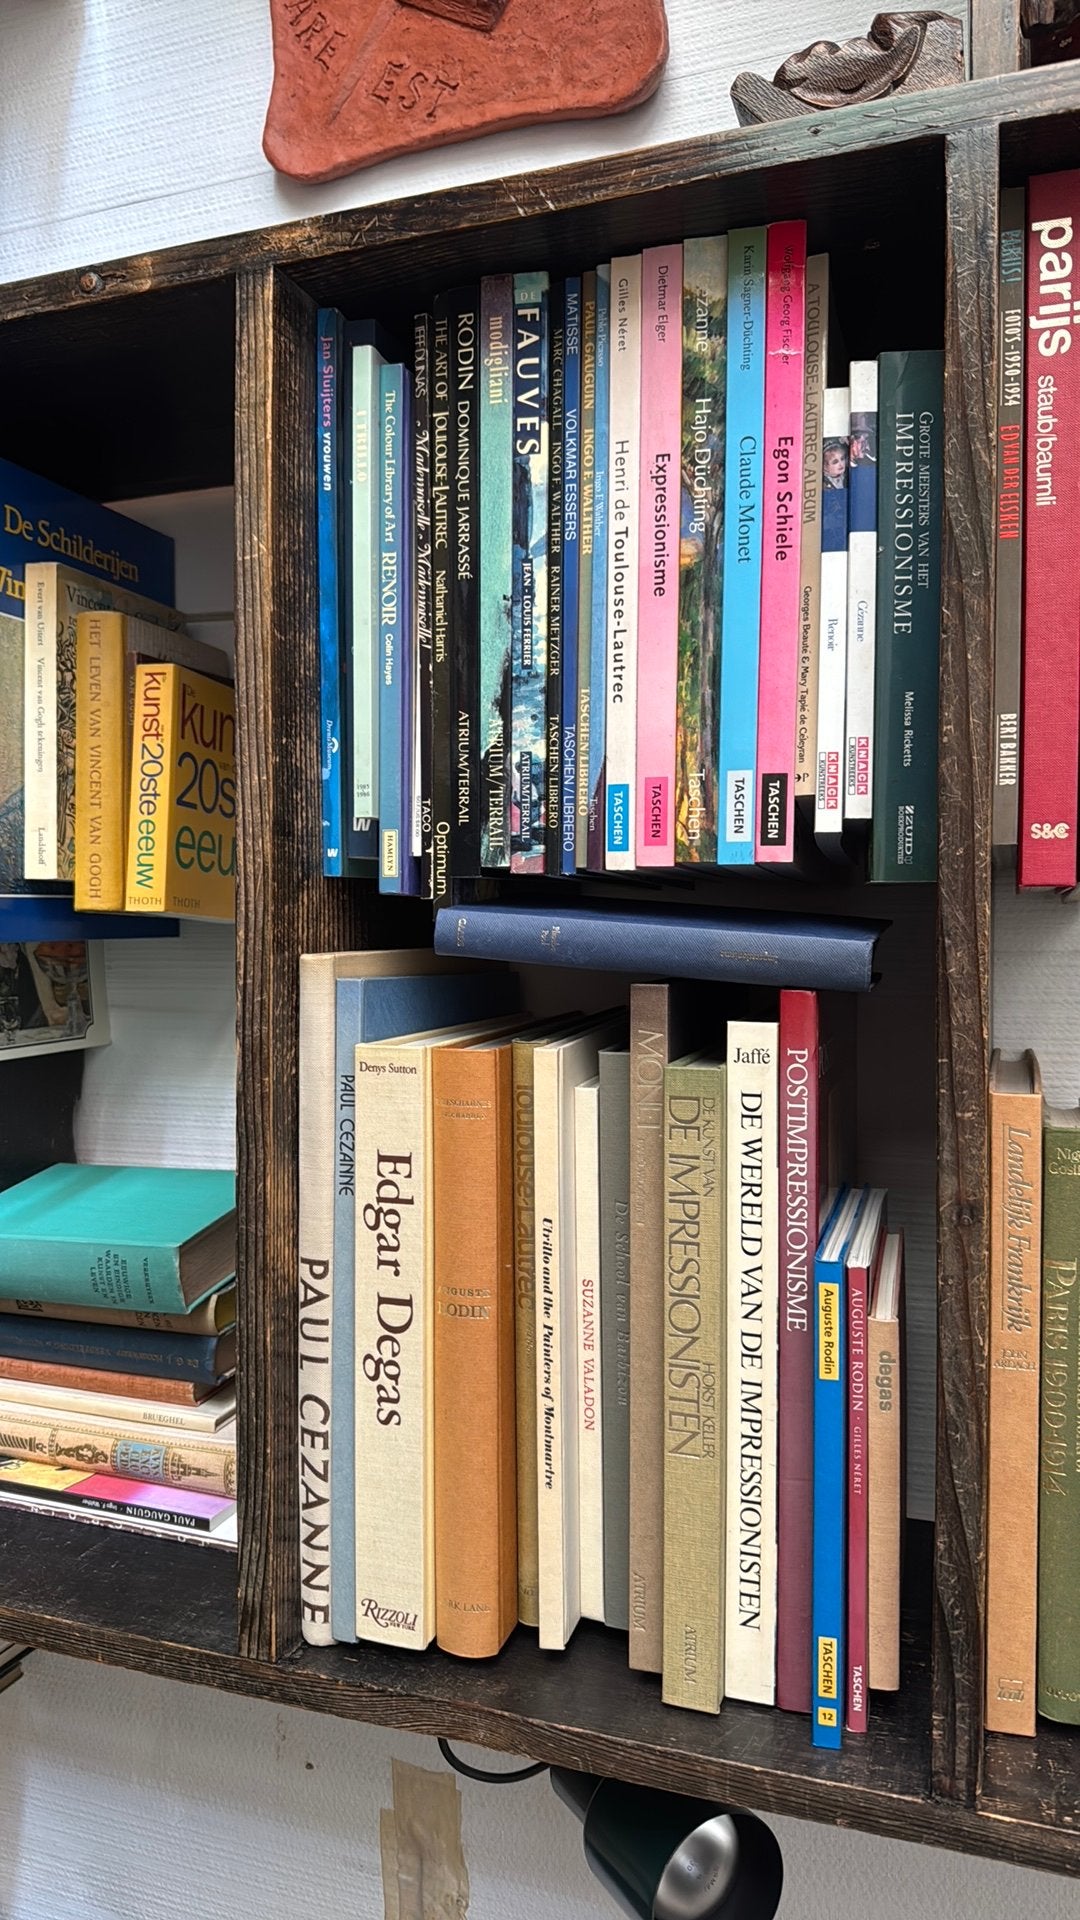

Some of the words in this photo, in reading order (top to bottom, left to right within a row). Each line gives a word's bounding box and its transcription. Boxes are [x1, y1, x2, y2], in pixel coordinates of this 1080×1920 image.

[370, 61, 460, 121] EST
[742, 245, 754, 276] Karin
[618, 278, 629, 313] Gilles
[657, 265, 669, 311] Dietmar
[808, 283, 820, 295] A
[1028, 217, 1080, 357] parijs
[435, 317, 447, 349] THE
[566, 293, 578, 356] MATISSE
[584, 301, 595, 340] PAUL
[617, 318, 629, 352] Néret
[655, 314, 668, 343] Elger
[740, 278, 754, 371] Sagner-Düchting
[322, 336, 333, 359] Jan
[435, 350, 448, 379] ART
[457, 312, 473, 390] RODIN
[485, 316, 507, 404] modigliani
[553, 329, 563, 366] MARC
[321, 365, 334, 427] Sluijters
[435, 381, 448, 401] OF
[516, 307, 540, 455] FAUVES
[552, 368, 563, 431] CHAGALL
[584, 343, 595, 410] GAUGUIN
[804, 296, 820, 464] TOULOUSE-LAUTREC
[385, 390, 396, 413] The
[691, 399, 712, 442] Hajo
[385, 415, 395, 457] Colour
[455, 400, 470, 501] DOMINIQUE
[565, 408, 577, 480] VOLKMAR
[584, 429, 595, 470] INGO
[1000, 424, 1019, 441] ED
[1001, 444, 1019, 464] VAN
[1035, 375, 1058, 507] staub/baumli
[322, 432, 333, 491] vrouwen
[382, 459, 396, 504] Library
[432, 412, 450, 549] TOULOUSE-LAUTREC
[552, 442, 562, 474] INGO
[614, 439, 629, 494] Henri
[739, 436, 756, 500] Claude
[773, 436, 793, 484] Egon
[1002, 468, 1019, 489] DER
[385, 506, 396, 519] of
[565, 483, 576, 541] ESSERS
[614, 499, 629, 521] de
[689, 448, 711, 534] Düchting
[802, 467, 817, 524] ALBUM
[385, 521, 395, 542] Art
[551, 491, 562, 554] WALTHER
[582, 485, 593, 555] WALTHER
[649, 453, 671, 597] Expressionisme
[737, 504, 755, 564] Monet
[774, 490, 793, 561] Schiele
[893, 412, 914, 635] IMPRESSIONISME
[998, 493, 1020, 539] ELSKEN
[4, 504, 33, 541] De
[37, 520, 139, 583] Schilderijen
[457, 506, 473, 580] JARRASSÉ
[381, 551, 397, 625] RENOIR
[435, 570, 448, 626] Nathaniel
[522, 562, 531, 588] JEAN
[550, 566, 560, 613] RAINER
[523, 595, 531, 626] LOUIS
[612, 526, 629, 704] Toulouse-Lautrec
[800, 586, 811, 622] Georges
[89, 619, 102, 647] HET
[384, 633, 393, 656] Colin
[435, 628, 447, 662] Harris
[522, 628, 531, 666] FERRIER
[549, 616, 559, 676] METZGER
[801, 624, 811, 654] Beauté
[827, 618, 838, 651] Renoir
[89, 657, 101, 701] LEVEN
[383, 658, 393, 686] Hayes
[798, 666, 809, 688] Mary
[800, 656, 810, 664] &
[89, 709, 101, 738] VAN
[142, 672, 167, 742] kunst
[798, 689, 810, 713] Tapié
[799, 714, 808, 725] de
[903, 691, 914, 726] Melissa
[458, 710, 470, 826] ATRIUM/TERRAIL
[564, 724, 575, 785] TASCHEN
[796, 726, 809, 764] Céleyran
[856, 737, 870, 795] KNACK
[903, 729, 914, 767] Ricketts
[89, 745, 102, 809] VINCENT
[138, 743, 164, 816] 20ste
[826, 752, 839, 810] KNACK
[421, 799, 431, 832] TACO
[563, 796, 575, 852] LIBRERO
[613, 791, 624, 845] TASCHEN
[650, 784, 662, 839] TASCHEN
[687, 768, 706, 840] Taschen
[733, 777, 745, 834] TASCHEN
[767, 780, 780, 839] TASCHEN
[36, 827, 46, 865] Landshoff
[89, 816, 101, 845] VAN
[136, 819, 156, 889] eeuw
[386, 835, 394, 872] HAMLYN
[89, 853, 102, 899] GOGH
[434, 821, 450, 895] Optimum
[129, 896, 162, 905] THOTH
[359, 1061, 388, 1075] Denys
[389, 1063, 417, 1074] Sutton
[734, 1047, 771, 1065] Jaffé
[340, 1074, 355, 1111] PAUL
[702, 1096, 716, 1116] DE
[740, 1090, 763, 1130] DE
[668, 1096, 701, 1141] DE
[702, 1119, 716, 1164] KUNST
[338, 1118, 354, 1196] CEZANNE
[1005, 1126, 1033, 1230] Landelijk
[703, 1168, 716, 1198] VAN
[740, 1137, 763, 1257] WERELD
[785, 1048, 809, 1332] POSTIMPRESSIONISME
[363, 1148, 414, 1277] Edgar
[541, 1217, 553, 1264] Utrillo
[542, 1267, 553, 1294] and
[740, 1265, 763, 1323] VAN
[1004, 1234, 1032, 1334] Frankrijk
[299, 1256, 329, 1371] PAUL
[542, 1297, 553, 1319] the
[581, 1278, 594, 1351] SUZANNE
[668, 1153, 701, 1460] IMPRESSIONISTEN
[822, 1288, 835, 1339] Auguste
[851, 1288, 863, 1356] AUGUSTE
[1044, 1258, 1077, 1351] PARIS
[362, 1292, 414, 1427] Degas
[542, 1324, 553, 1384] Painters
[740, 1329, 763, 1370] DE
[823, 1341, 835, 1375] Rodin
[541, 1387, 554, 1403] of
[582, 1357, 595, 1431] VALADON
[702, 1362, 715, 1410] HORST
[852, 1360, 864, 1411] RODIN
[875, 1350, 897, 1411] degas
[143, 1412, 186, 1426] BRUEGHEL
[702, 1415, 716, 1459] KELLER
[1042, 1357, 1070, 1496] 1900-1914
[543, 1404, 555, 1490] Montmartre
[853, 1426, 863, 1461] GILLES
[853, 1463, 864, 1495] NÉRET
[126, 1506, 168, 1524] GAUGUIN
[172, 1514, 196, 1527] PAUL
[300, 1394, 331, 1625] CEZANNE
[738, 1378, 763, 1632] IMPRESSIONISTEN
[360, 1598, 418, 1628] RIZZOLI
[684, 1624, 697, 1684] ATRIUM
[822, 1641, 834, 1695] TASCHEN
[852, 1665, 863, 1712] TASCHEN
[823, 1712, 834, 1722] 12
